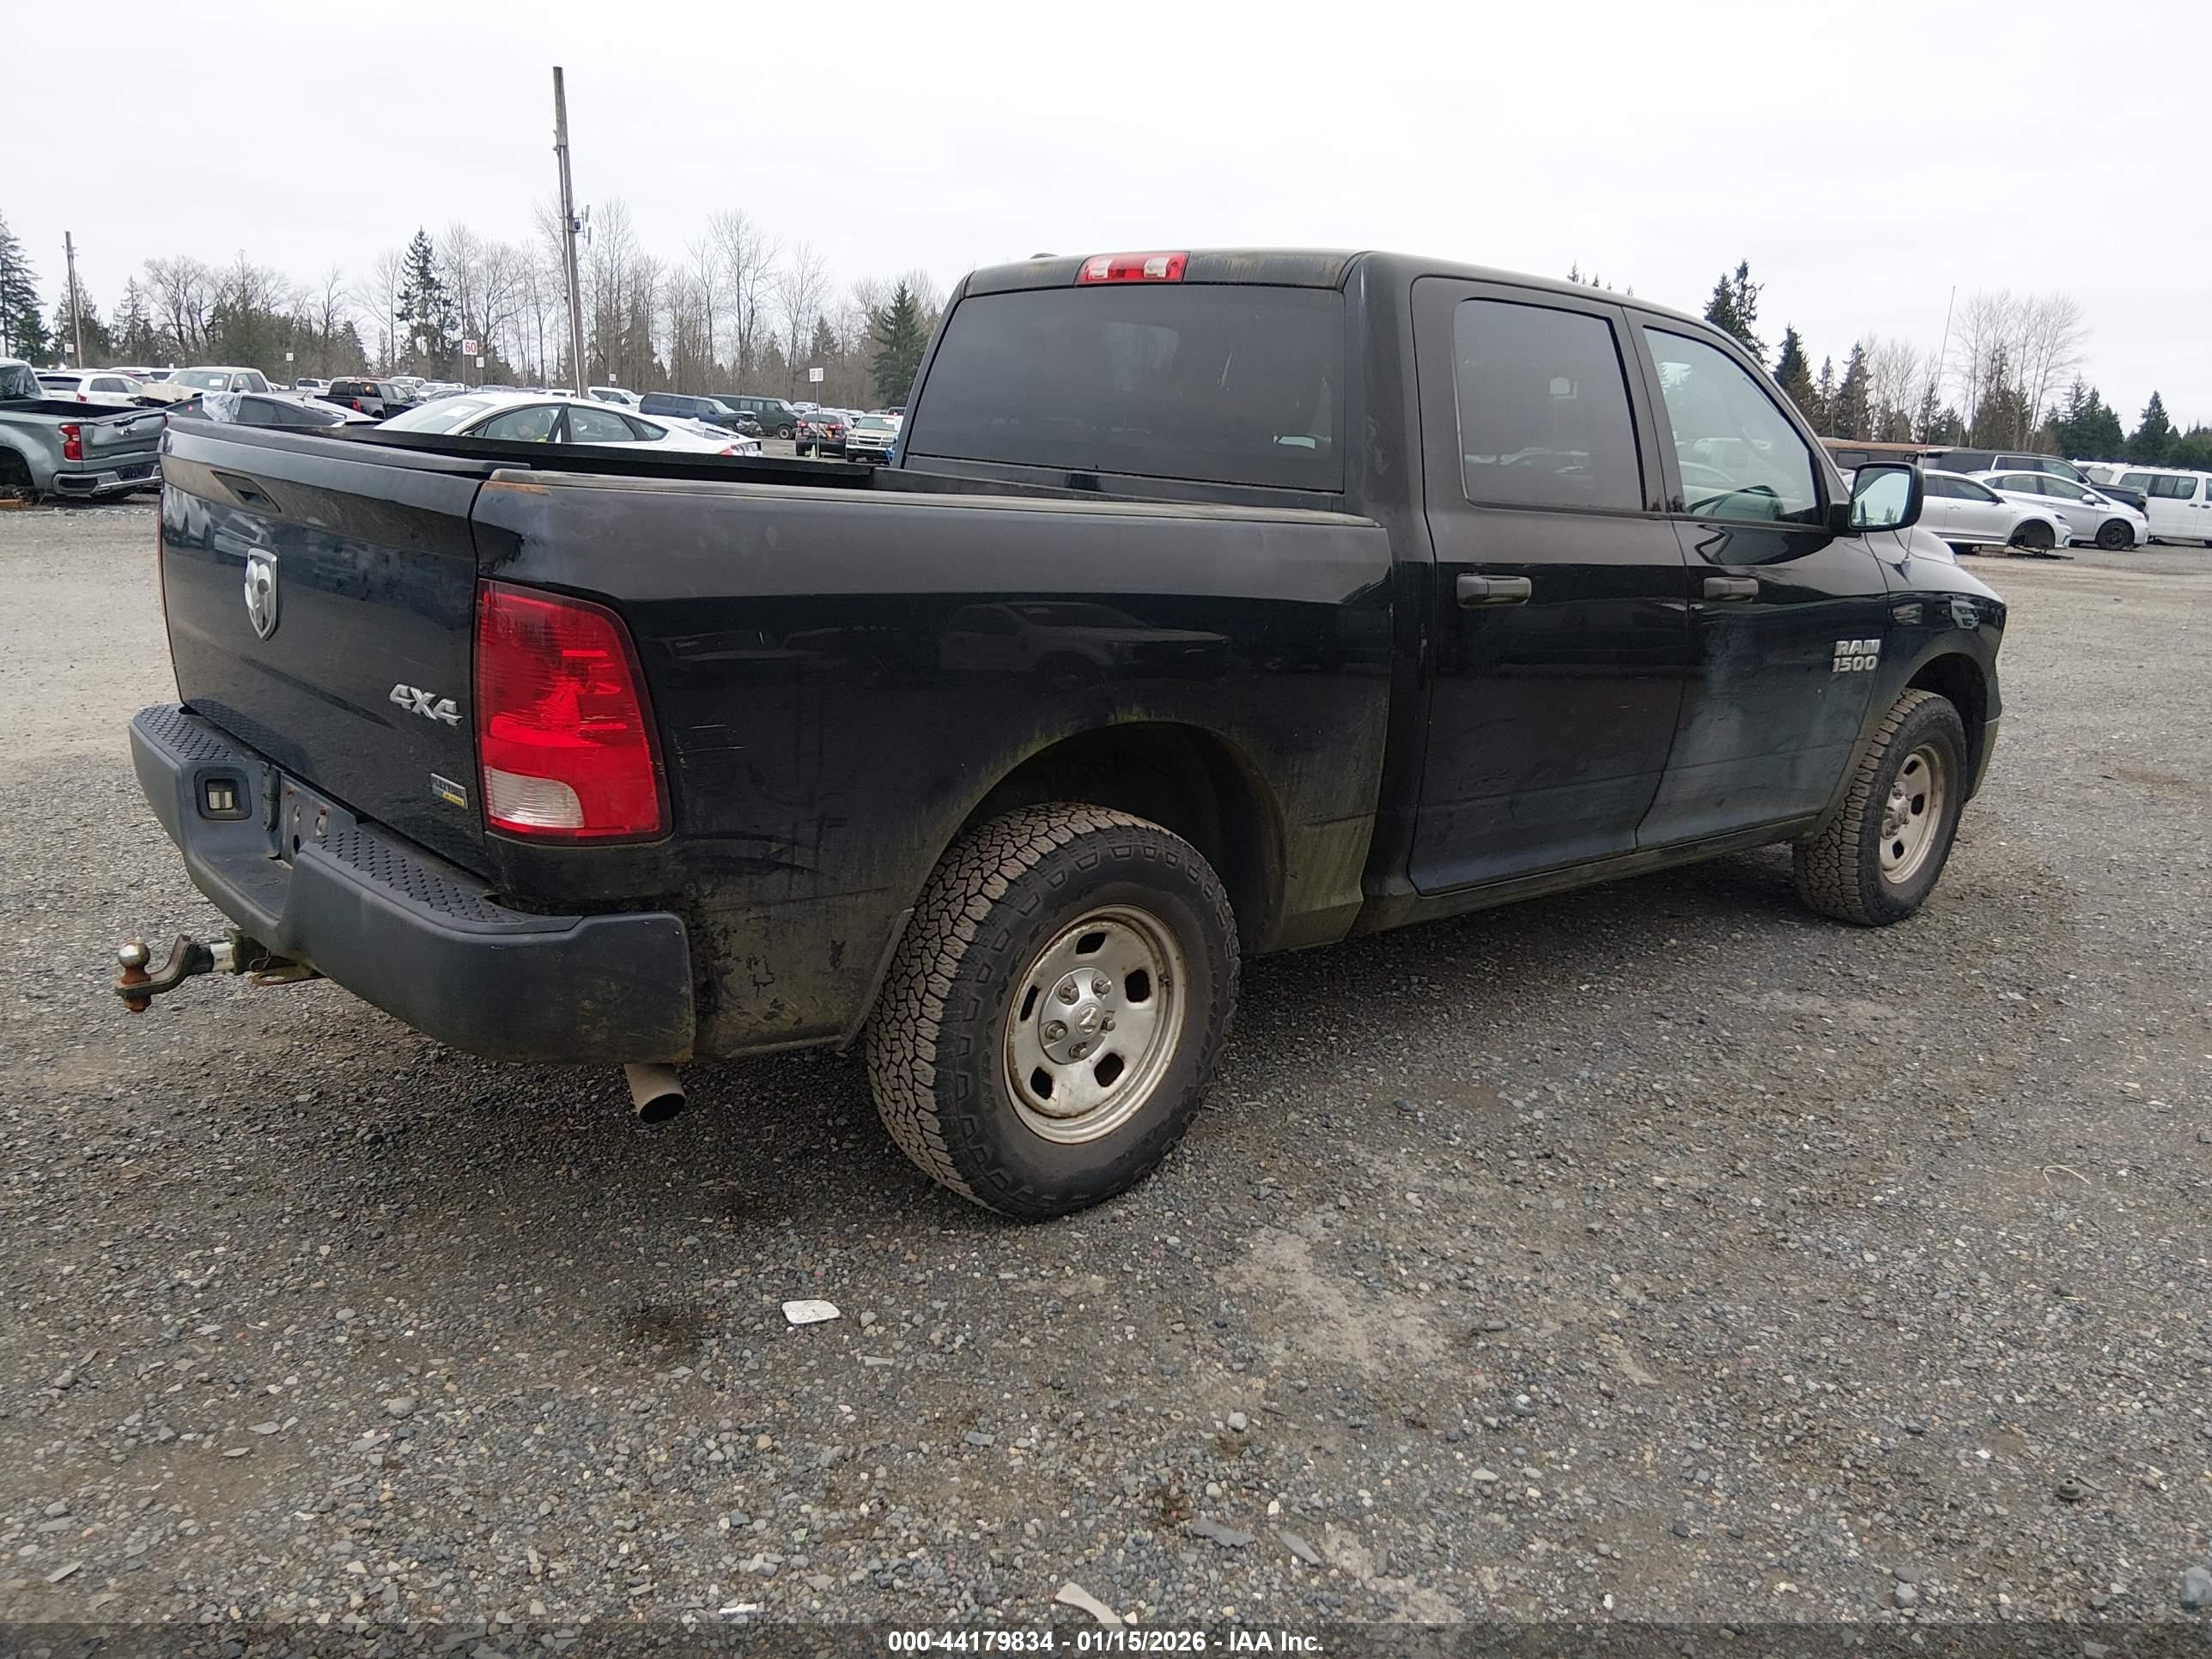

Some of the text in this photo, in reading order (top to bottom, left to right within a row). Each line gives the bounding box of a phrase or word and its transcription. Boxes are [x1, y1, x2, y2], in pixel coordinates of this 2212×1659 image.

[465, 342, 476, 352] 60
[1834, 639, 1881, 656] RAM
[1832, 656, 1877, 672] 1500
